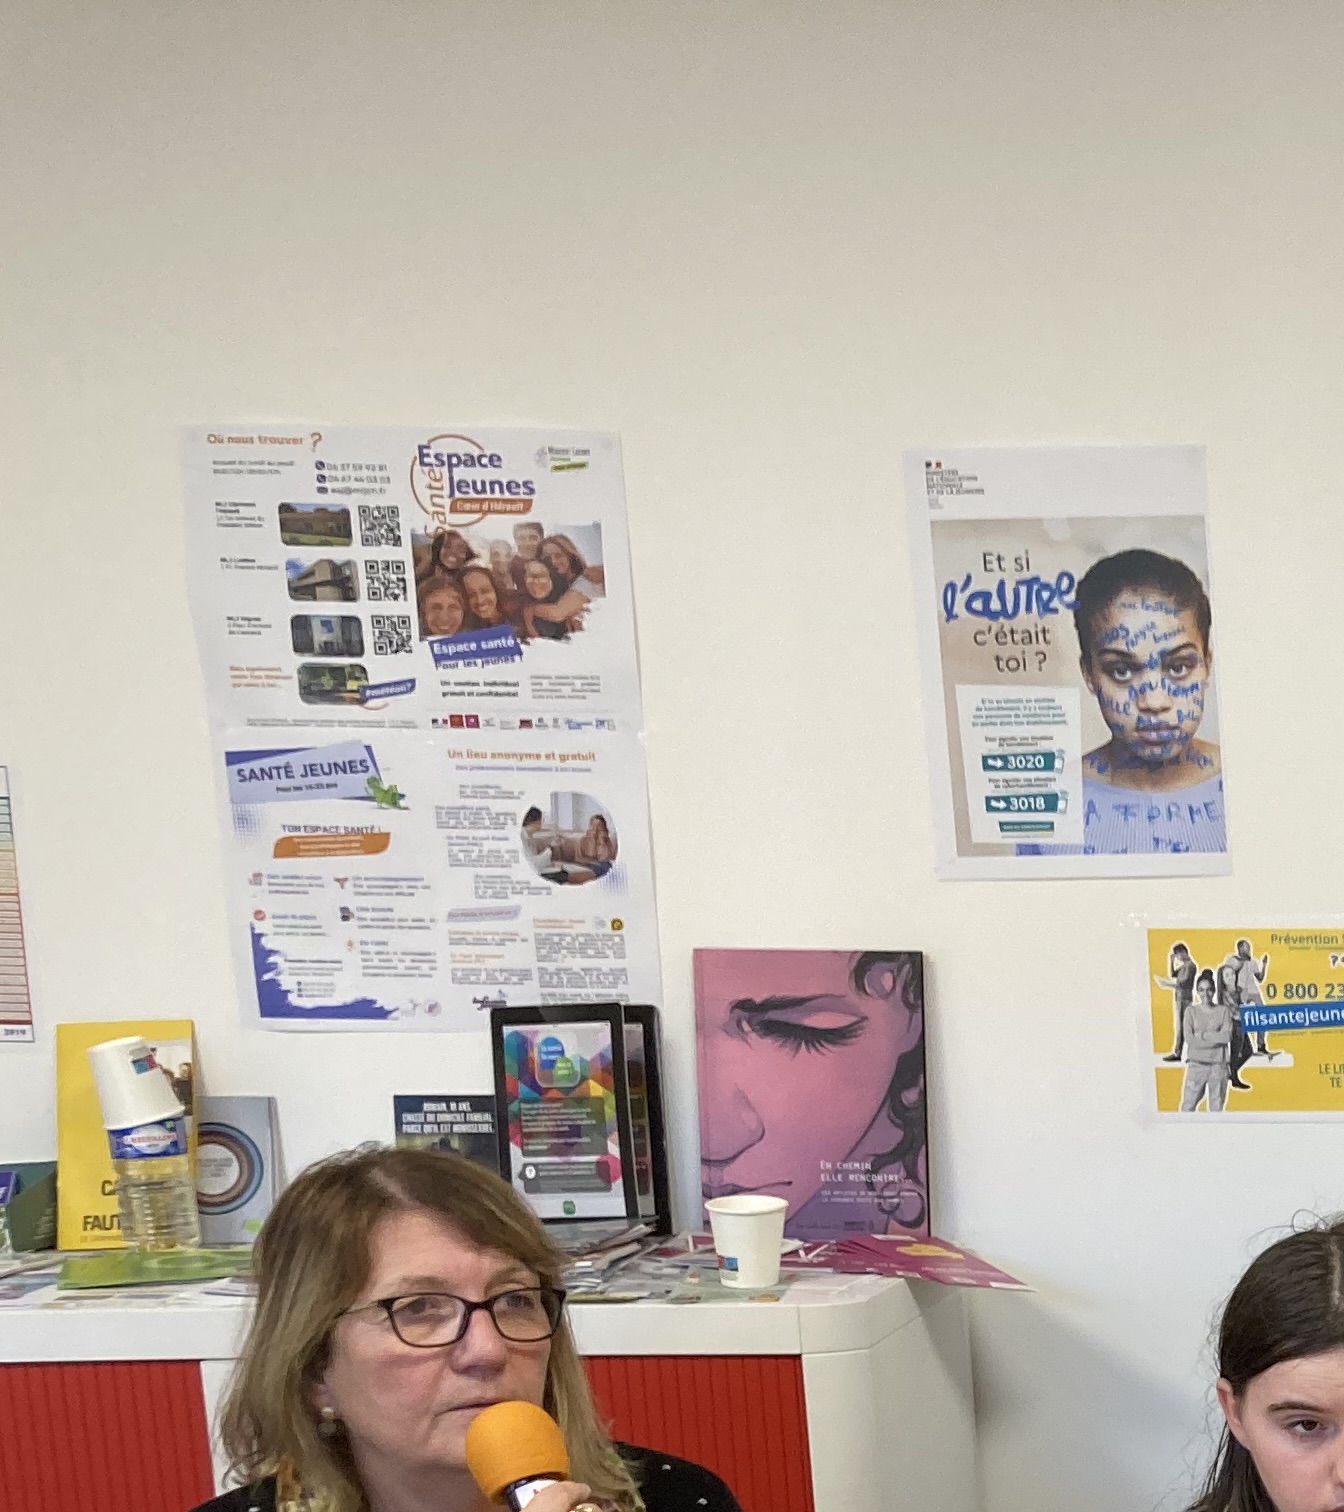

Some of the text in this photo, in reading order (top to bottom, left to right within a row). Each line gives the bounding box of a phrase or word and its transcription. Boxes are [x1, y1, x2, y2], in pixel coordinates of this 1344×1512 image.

[418, 445, 503, 475] Espace
[982, 550, 1031, 573] Et si
[972, 622, 1051, 647] c'était
[993, 650, 1048, 673] toi ?
[236, 758, 370, 783] SANTÉ JEUNES
[1007, 754, 1045, 769] 3020
[1009, 796, 1046, 810] 3018
[1270, 932, 1339, 946] Prévention
[1266, 983, 1278, 1000] 0
[1283, 983, 1319, 1000] 800
